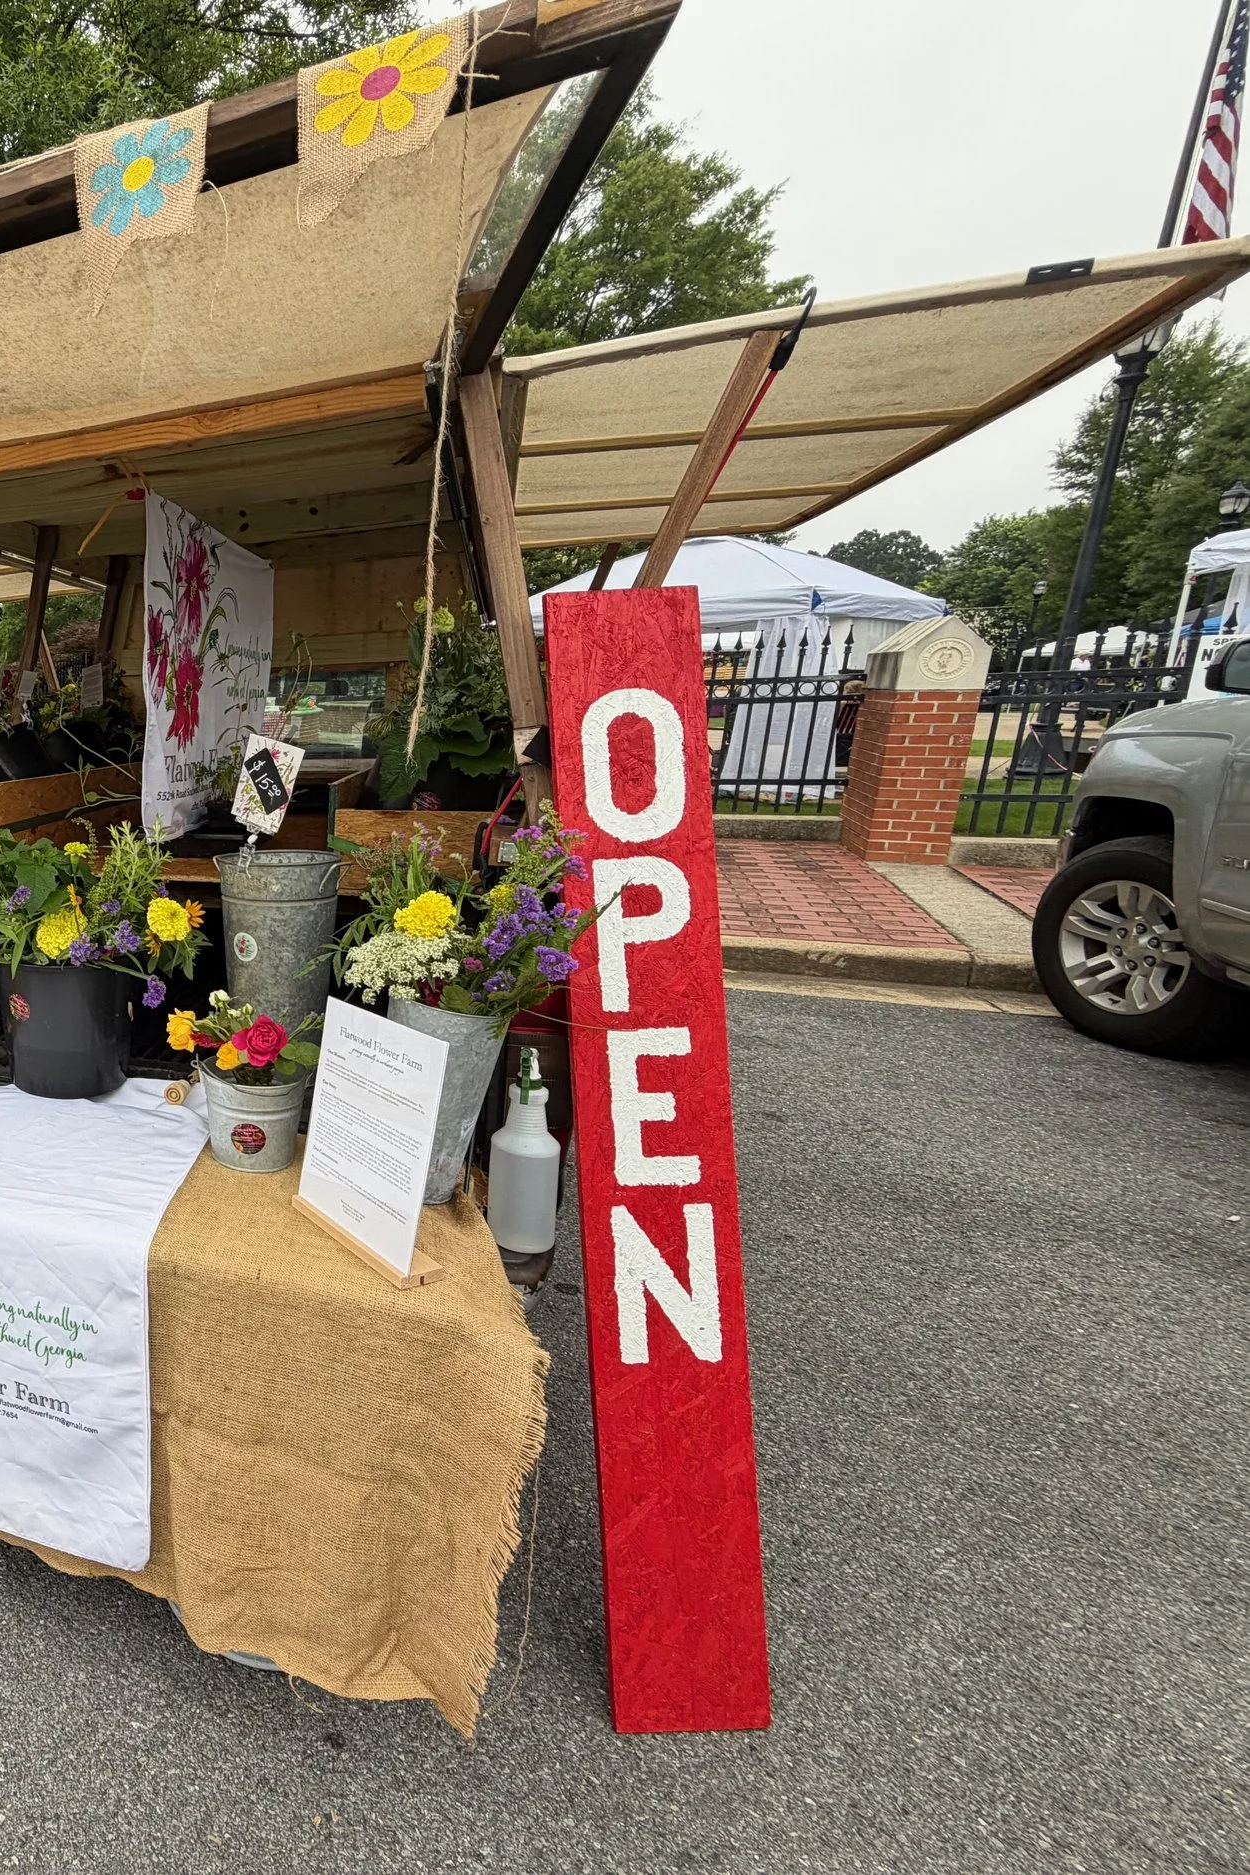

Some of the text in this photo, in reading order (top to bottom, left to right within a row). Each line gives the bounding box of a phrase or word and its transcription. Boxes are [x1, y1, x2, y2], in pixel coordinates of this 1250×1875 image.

[580, 687, 722, 1364] OPEN
[339, 1026, 423, 1072] Flatwood Flower Farm
[17, 1301, 81, 1341] naturally
[82, 1320, 98, 1334] in
[35, 1336, 87, 1368] Georgia
[14, 1380, 71, 1415] Farm
